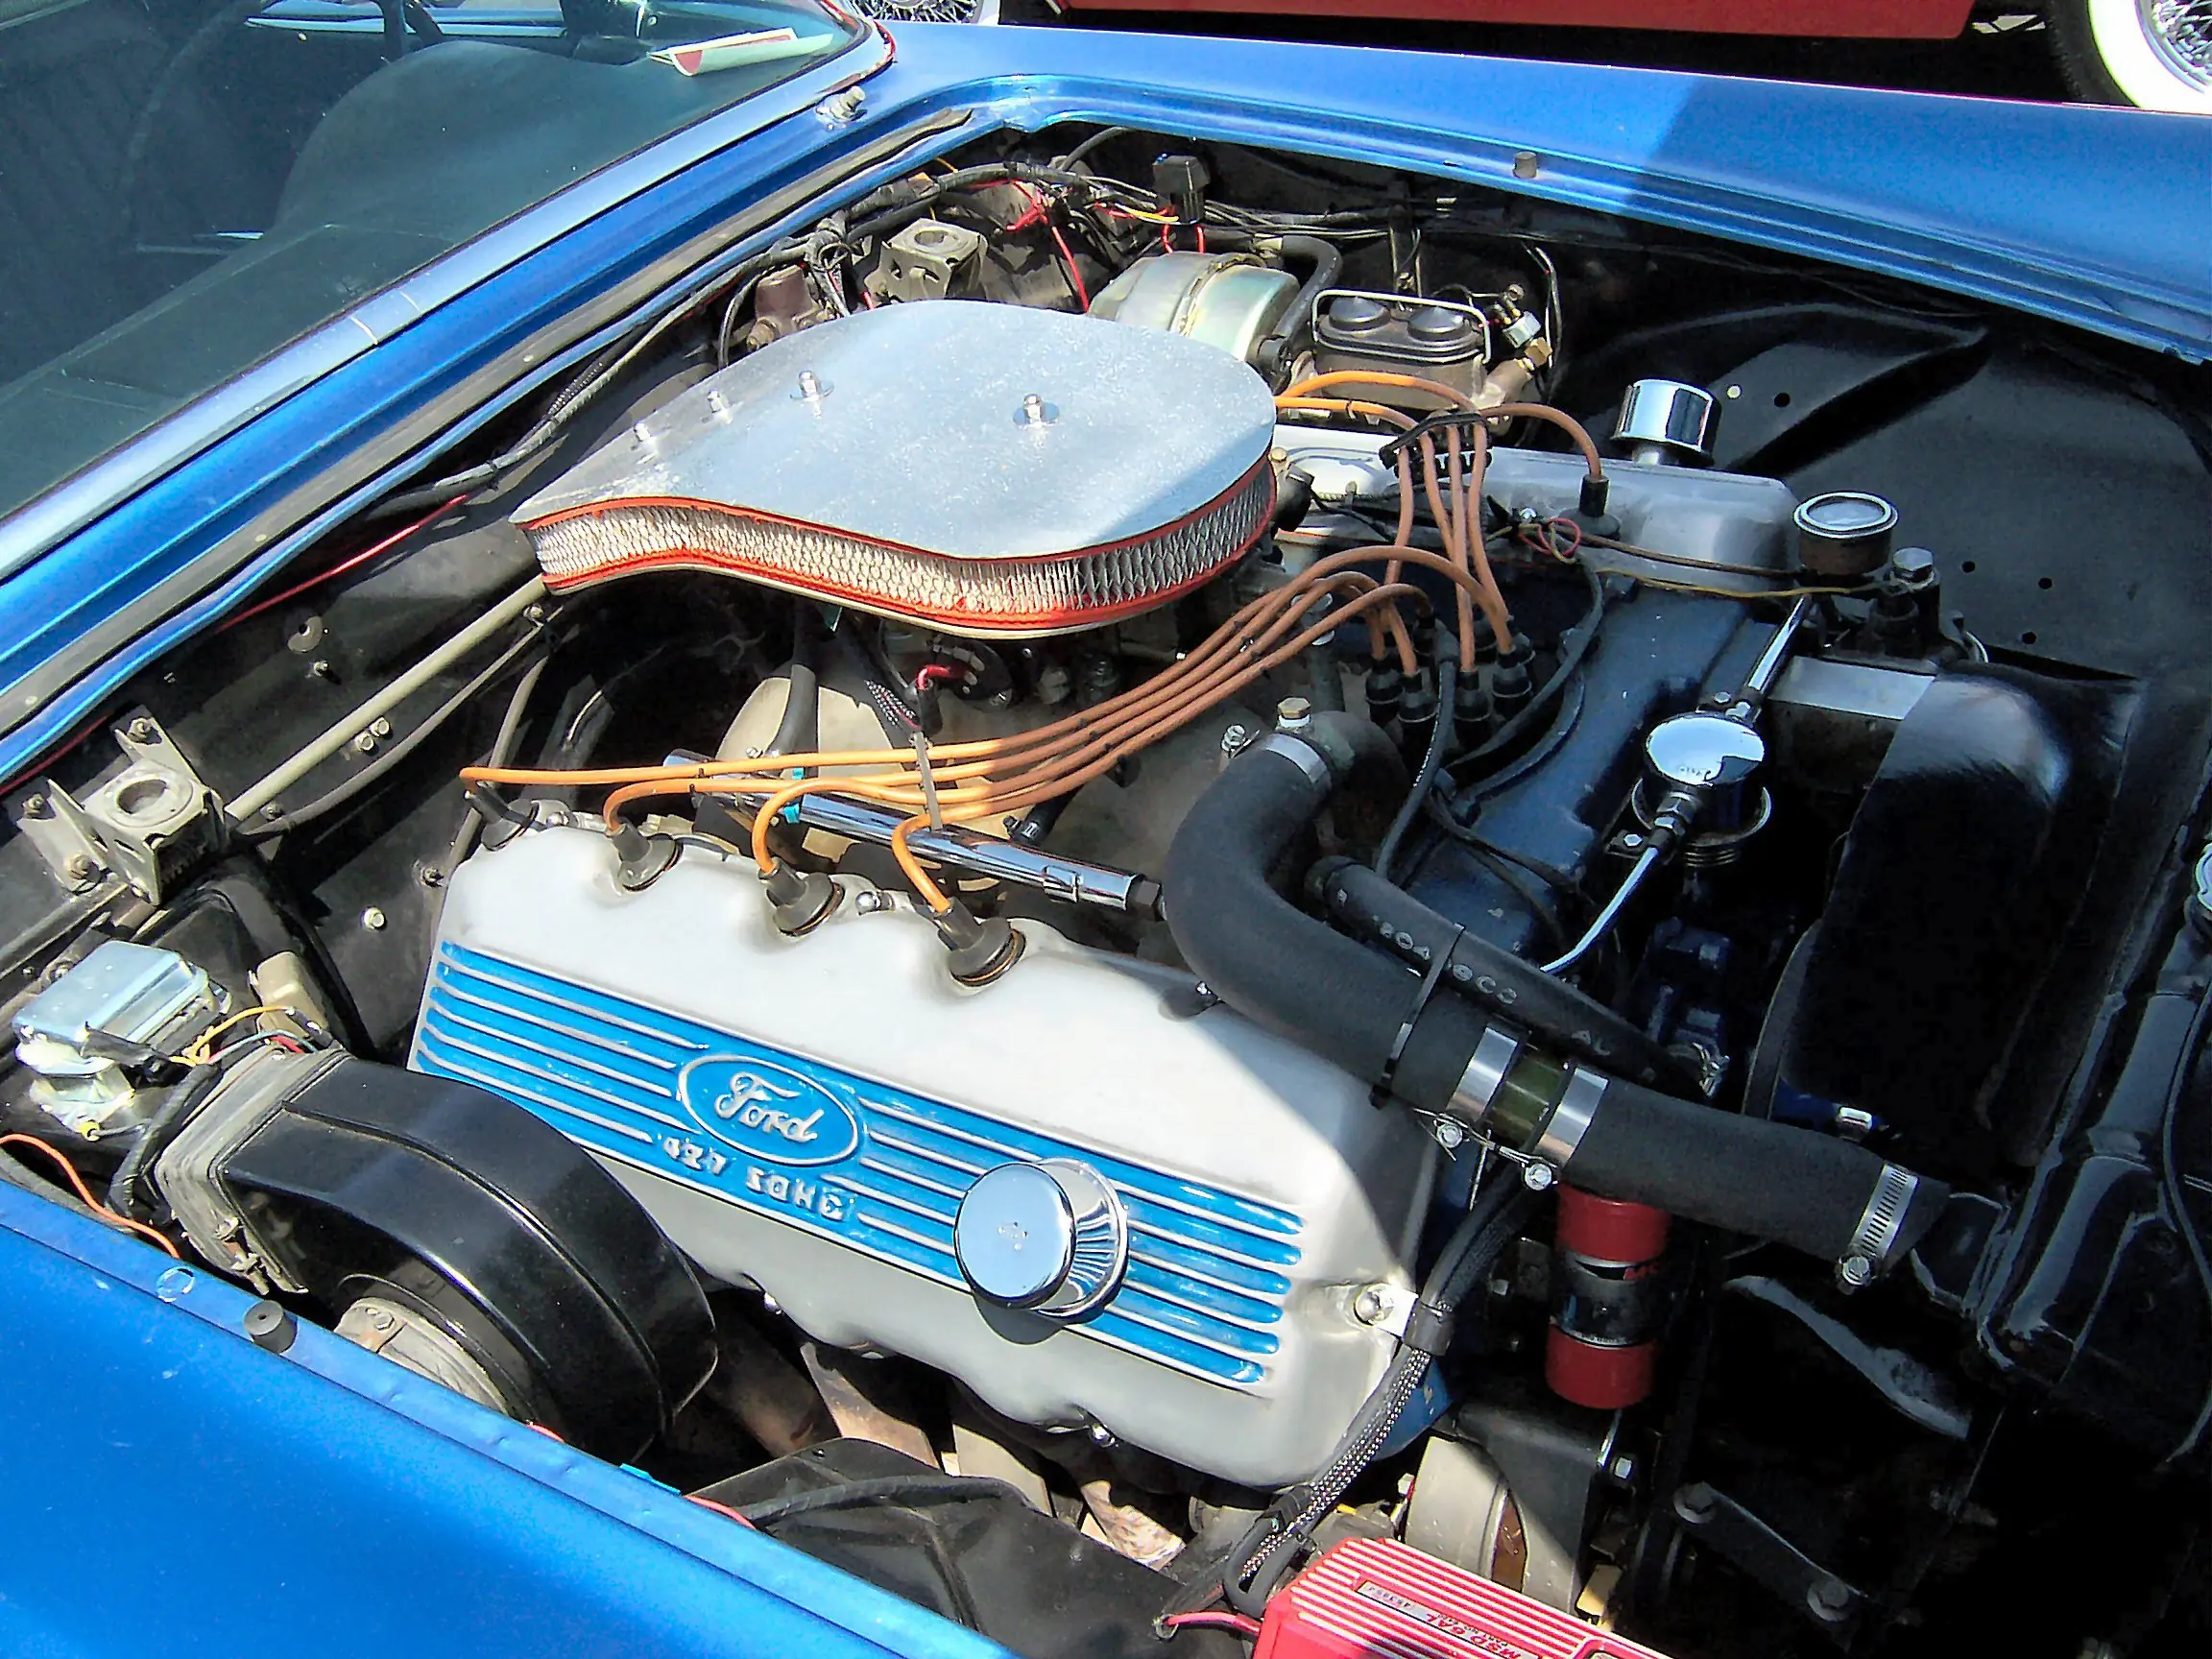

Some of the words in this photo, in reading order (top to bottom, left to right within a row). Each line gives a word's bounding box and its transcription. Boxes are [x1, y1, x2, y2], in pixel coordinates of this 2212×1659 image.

[714, 1072, 824, 1142] Ford
[661, 1137, 727, 1176] 427
[1426, 1613, 1466, 1635] 6AL
[1470, 1635, 1522, 1659] MSD
